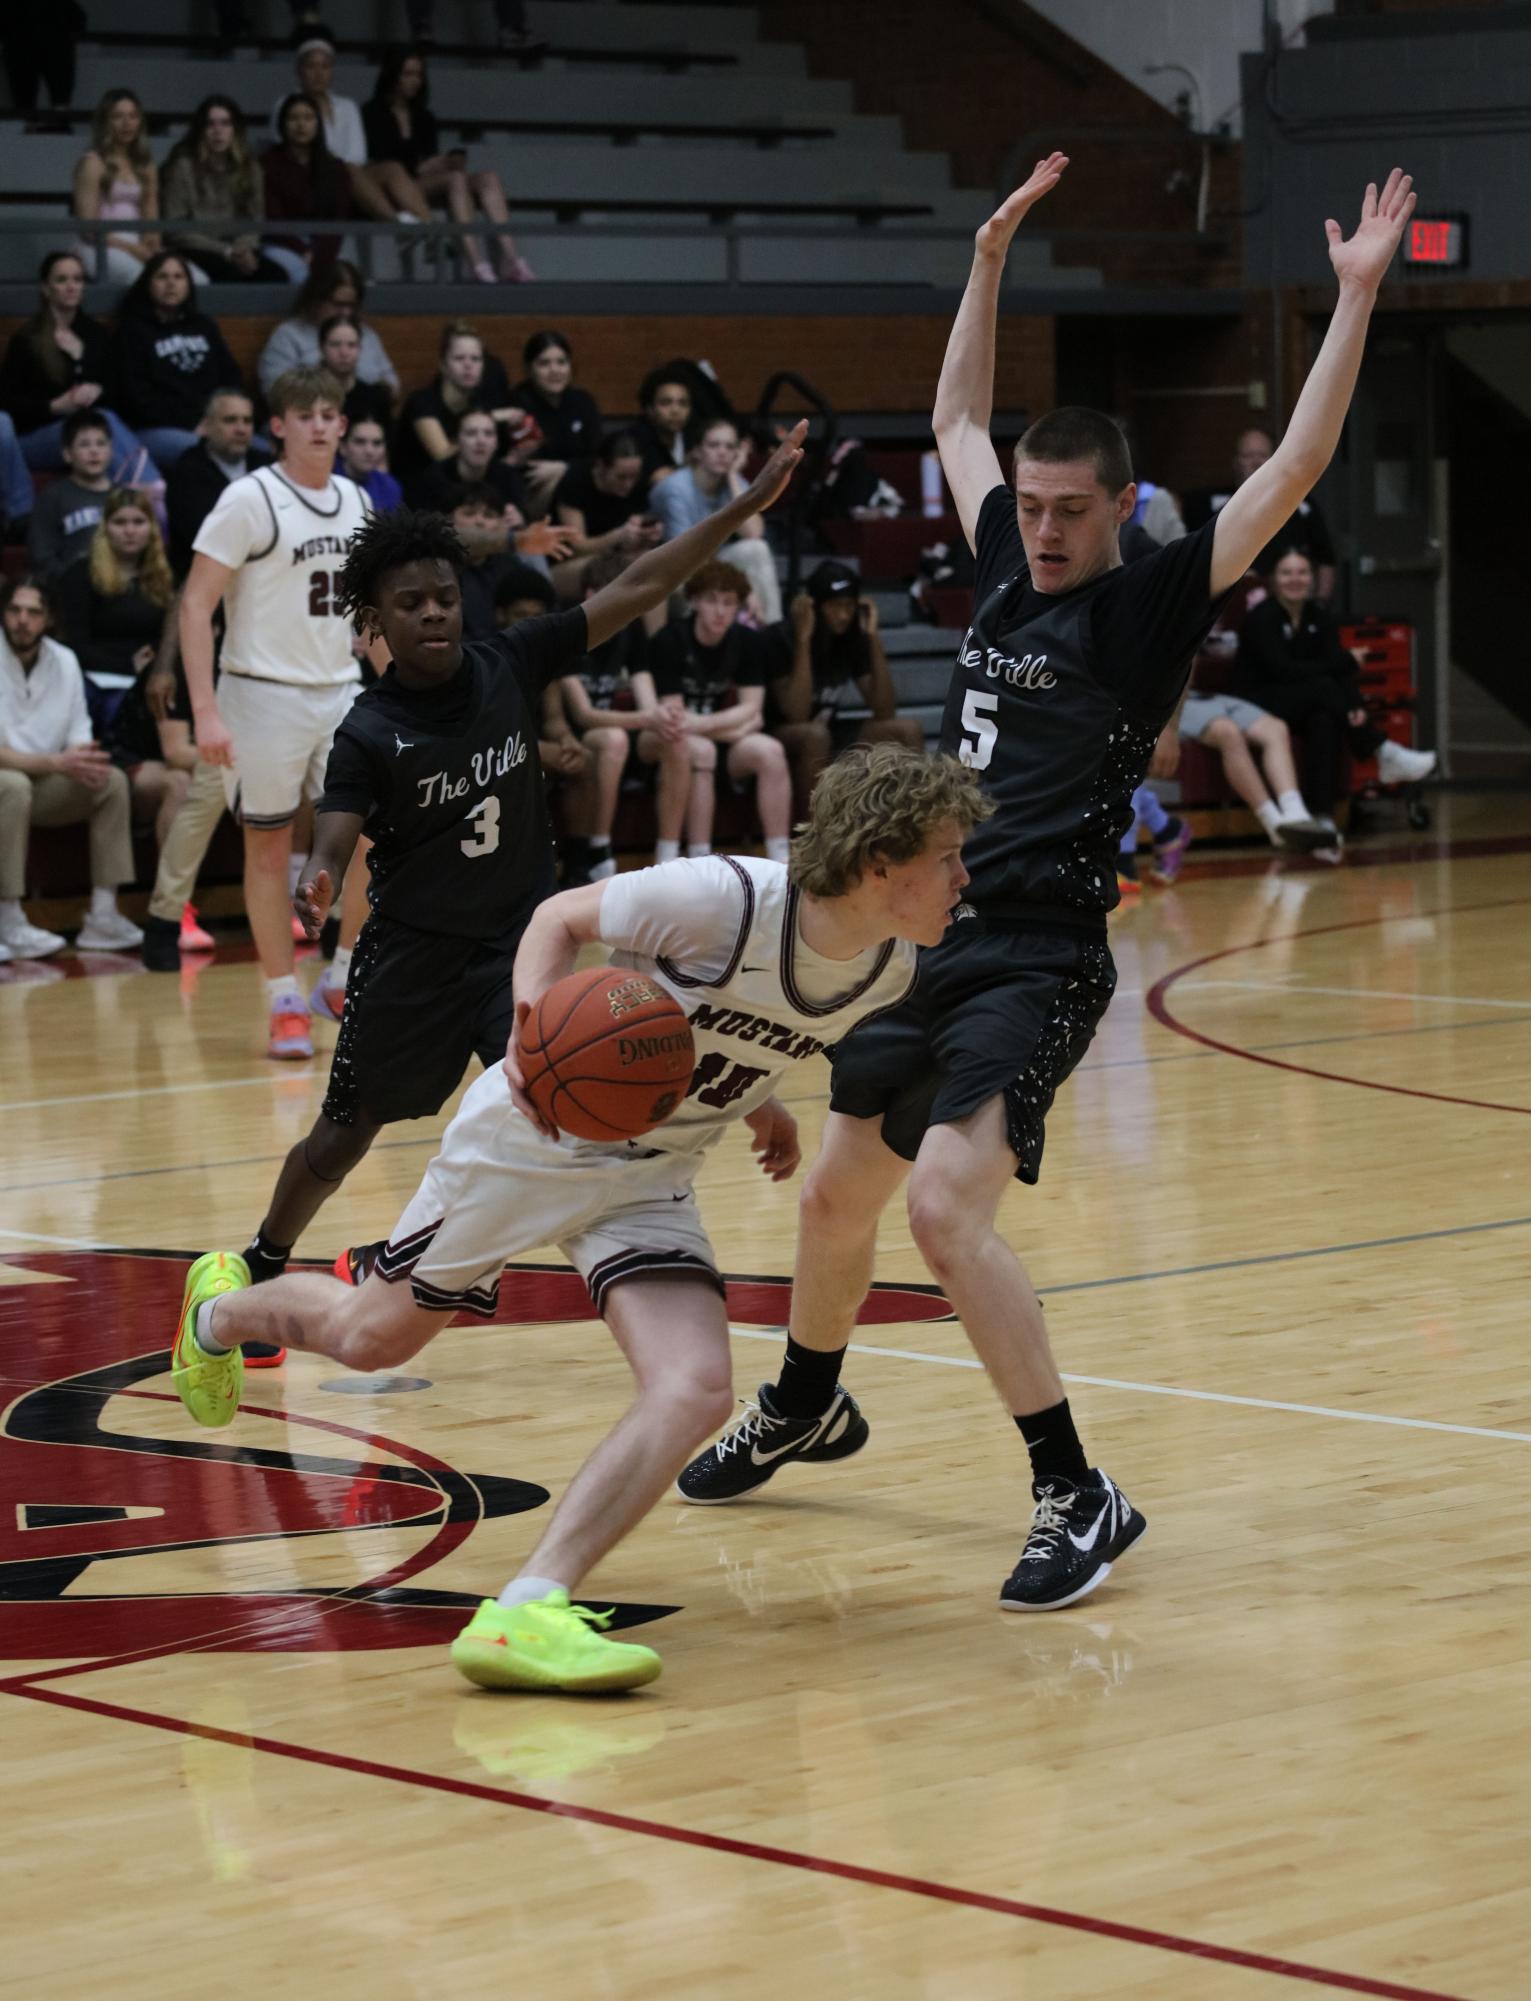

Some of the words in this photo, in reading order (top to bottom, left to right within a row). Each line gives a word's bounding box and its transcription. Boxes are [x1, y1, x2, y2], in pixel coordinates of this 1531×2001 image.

[985, 646, 1058, 691] Ville
[957, 687, 999, 771] 5
[416, 769, 471, 808] The
[470, 730, 528, 788] Ville
[459, 794, 501, 858] 3
